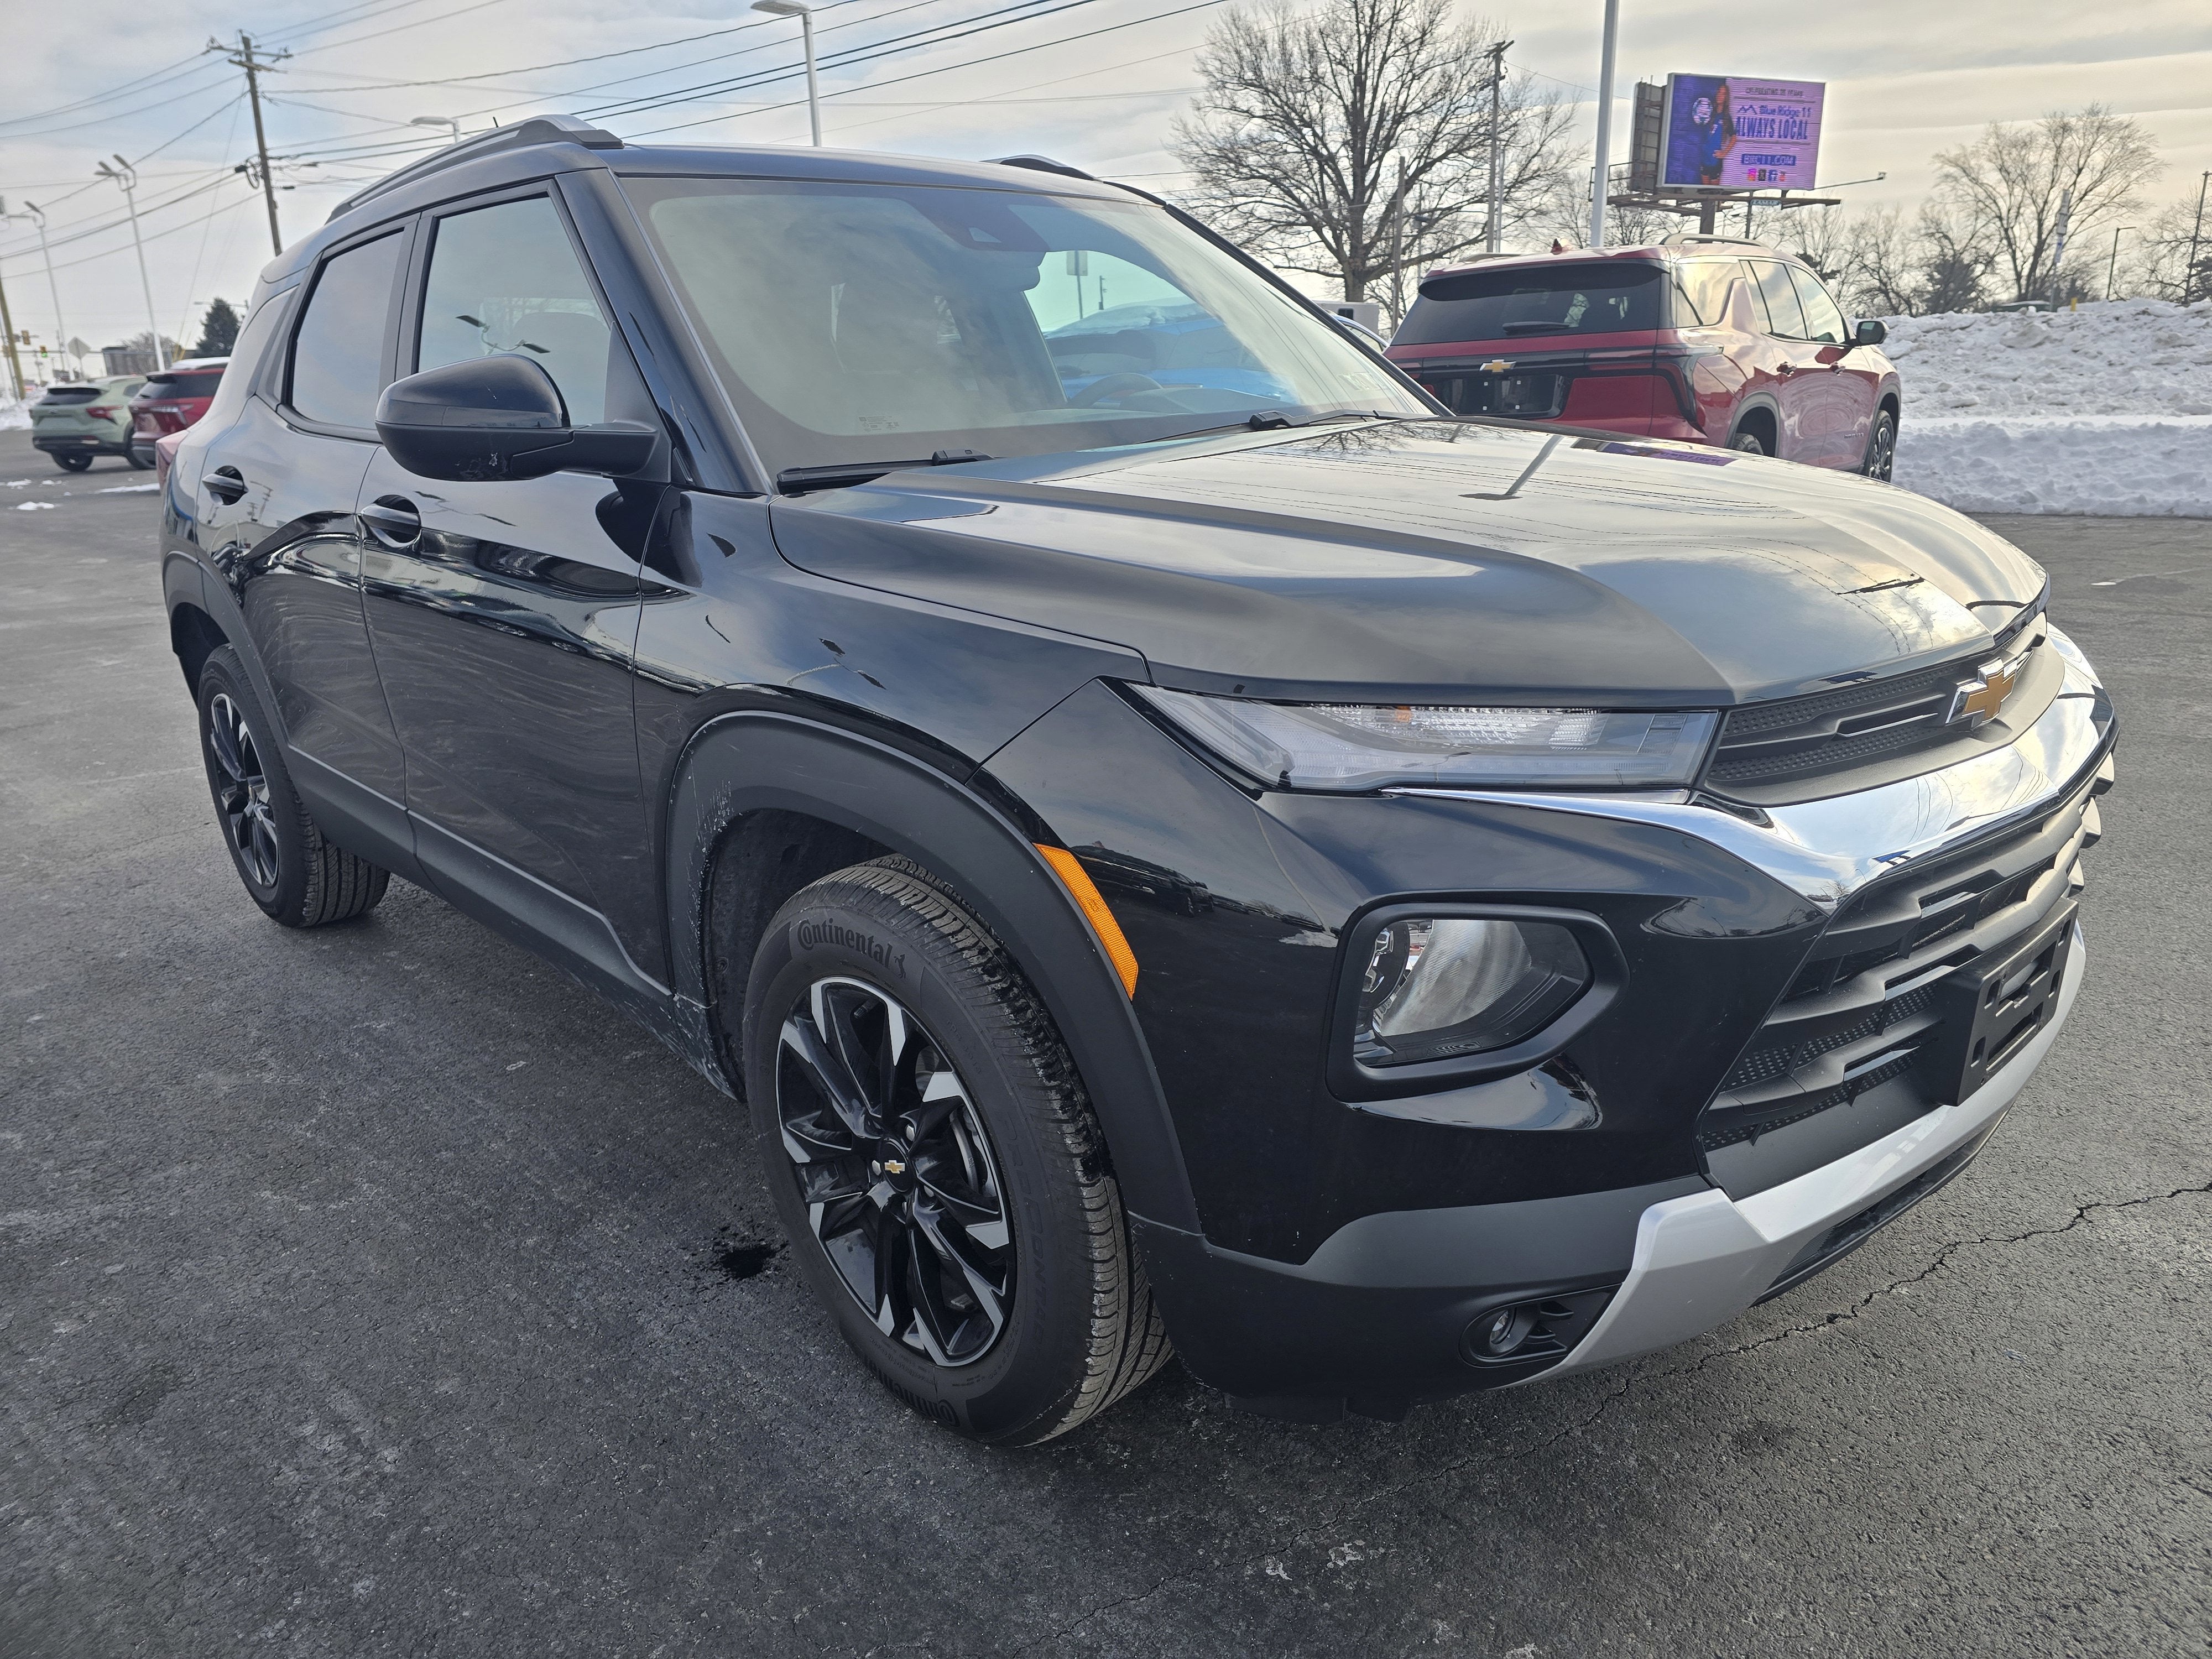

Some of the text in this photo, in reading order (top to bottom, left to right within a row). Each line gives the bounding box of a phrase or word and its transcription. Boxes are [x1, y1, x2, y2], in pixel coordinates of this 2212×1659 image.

[1736, 116, 1808, 139] ALWAYS LOCAL
[798, 919, 893, 969] Continental
